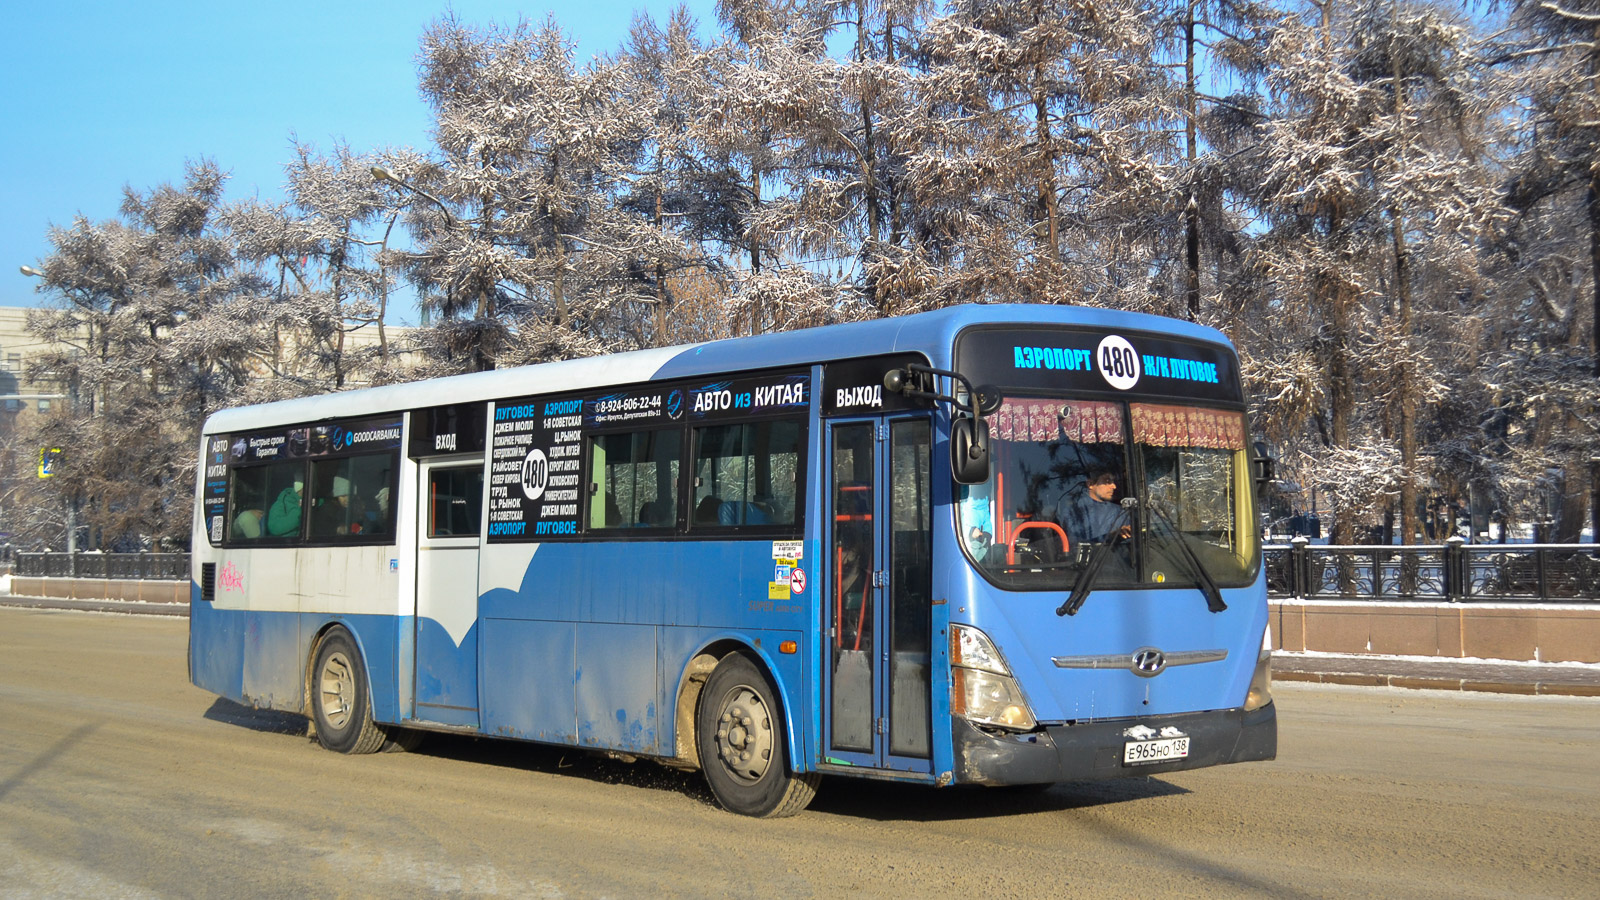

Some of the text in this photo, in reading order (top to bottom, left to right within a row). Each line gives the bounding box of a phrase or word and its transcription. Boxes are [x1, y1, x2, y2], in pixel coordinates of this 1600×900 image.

[1014, 346, 1092, 372] АЭРОПОРТ
[1101, 346, 1136, 379] 480
[1143, 354, 1219, 384] Ж/К ЛУГОВОЕ
[694, 390, 731, 412] АВТО
[734, 392, 751, 408] из
[754, 382, 804, 407] КИТАЯ
[836, 384, 882, 408] ВЫХОД
[544, 400, 584, 416] АЭРОПОРТ
[600, 395, 662, 412] 8-924-606-22-44
[496, 404, 534, 420] ЛУГОВОЕ
[495, 420, 534, 434] ДЖЕМ МОЛЛ
[543, 415, 582, 429] 1-Я СОВЕТСКАЯ
[250, 437, 270, 448] Быстрые
[353, 429, 400, 444] GOODCARBAIKAL
[435, 433, 456, 450] ВХОД
[212, 440, 228, 453] АВТО
[256, 446, 278, 458] Гарантии
[208, 464, 226, 478] КИТАЯ
[492, 461, 522, 472] РАЙСОВЕТ
[549, 460, 580, 472] КУРОРТ АНГАРА
[492, 474, 520, 484] СКВЕР КИРОВА
[524, 459, 544, 488] 480
[549, 474, 578, 486] ЖУКОВСКОГО
[492, 486, 508, 498] ТРУД
[498, 498, 522, 508] РЫНОК
[490, 511, 524, 521] 1-Я СОВЕТСКАЯ
[541, 504, 577, 518] ДЖЕМ МОЛЛ
[489, 522, 526, 536] АЭРОПОРТ
[536, 520, 576, 535] ЛУГОВОЕ
[748, 600, 774, 612] SUPER
[1129, 740, 1186, 760] Е965НО 138
